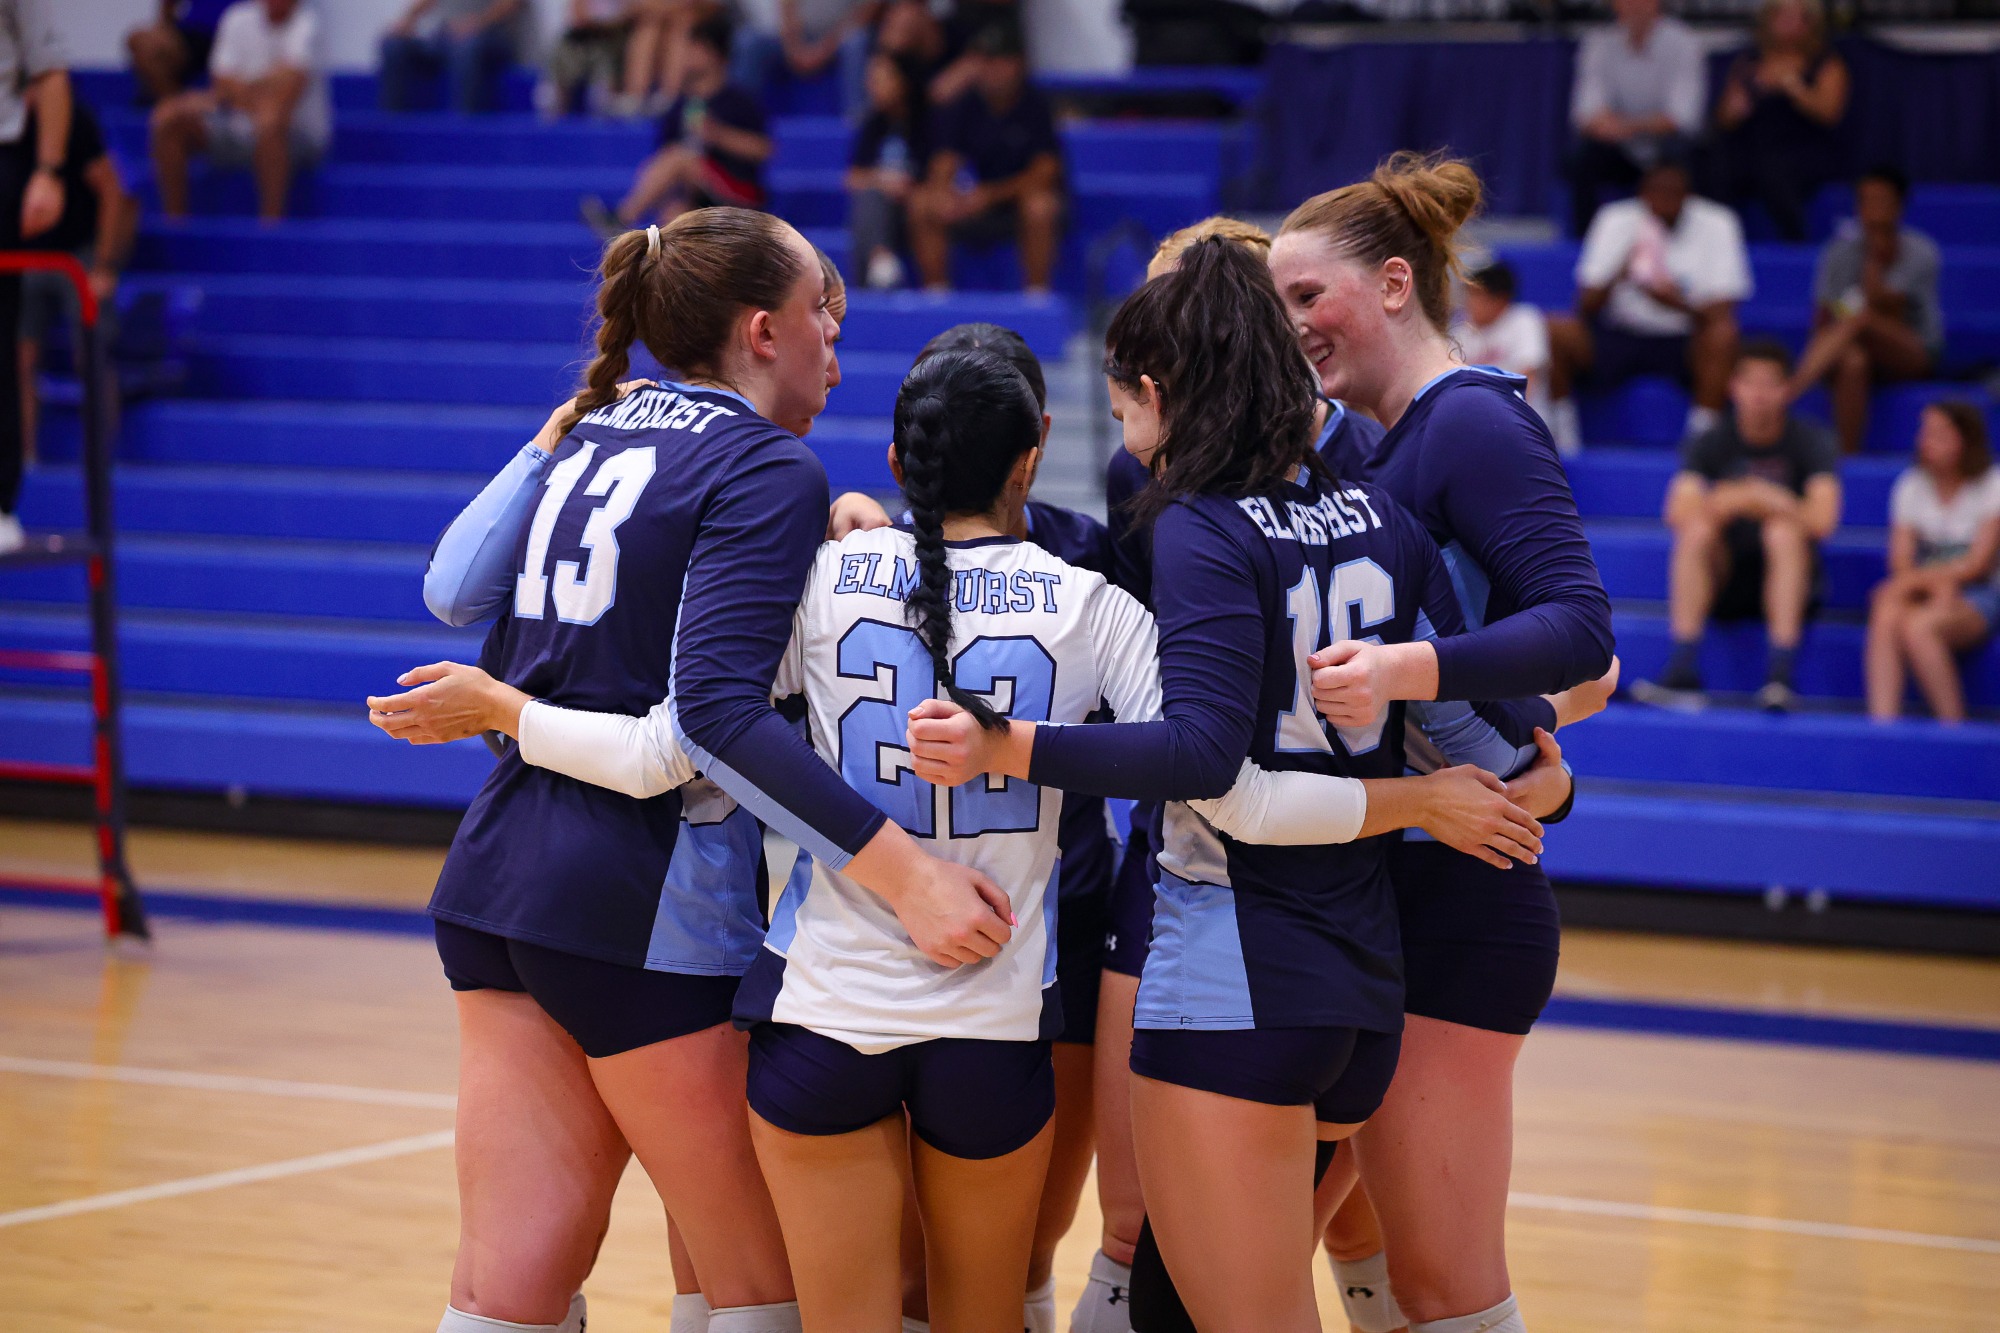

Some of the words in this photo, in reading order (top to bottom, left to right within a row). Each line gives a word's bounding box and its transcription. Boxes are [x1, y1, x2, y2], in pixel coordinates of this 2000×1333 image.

[515, 440, 657, 627] 13
[833, 552, 1061, 614] ELMURST
[836, 616, 1057, 840] 22
[1274, 556, 1395, 757] 16
